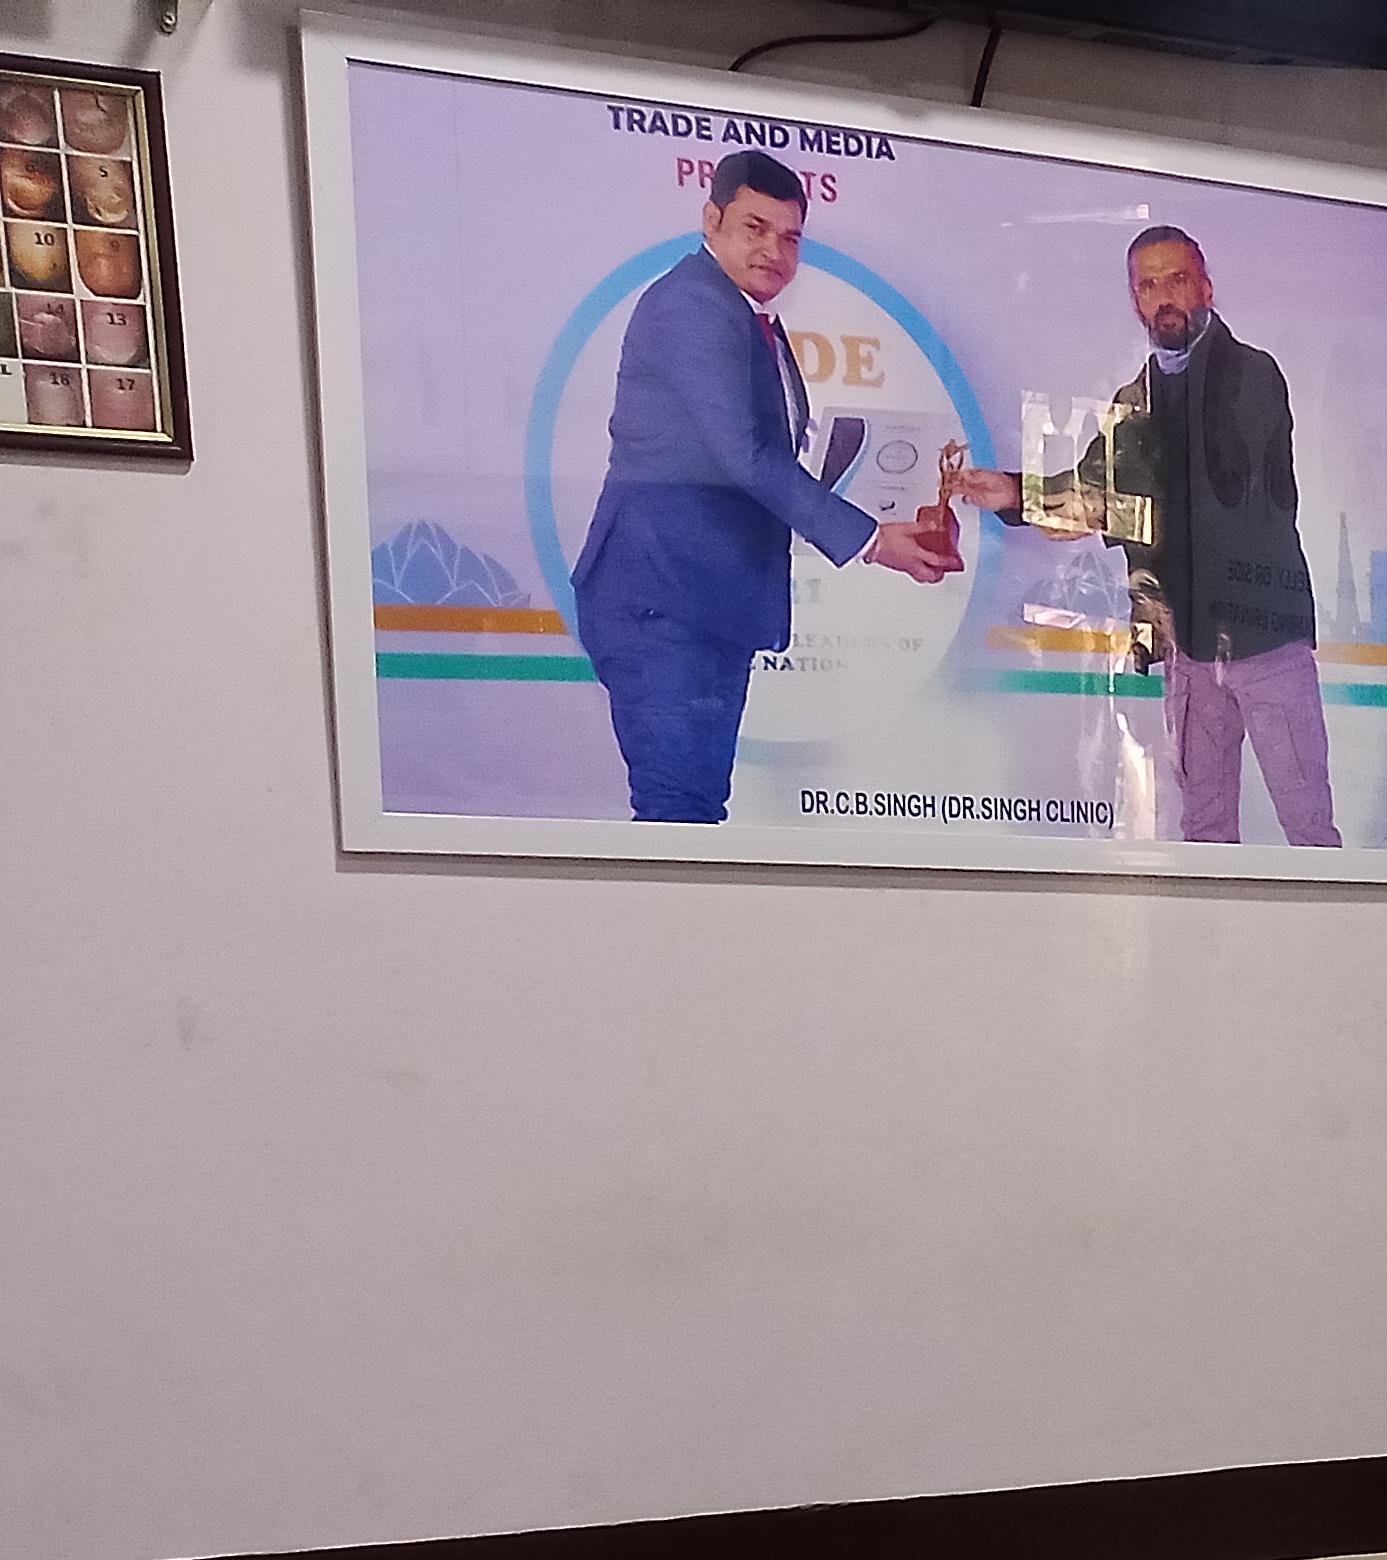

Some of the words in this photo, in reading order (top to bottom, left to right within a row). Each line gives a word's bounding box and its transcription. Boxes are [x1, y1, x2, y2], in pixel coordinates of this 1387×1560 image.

[606, 105, 712, 141] TRADE
[722, 120, 790, 149] AND
[799, 127, 897, 161] MEDIA
[34, 232, 55, 246] 10
[116, 378, 136, 391] 17
[800, 790, 936, 818] DR.C.B.SINGH
[941, 795, 1041, 825] (DR.SINGH
[1046, 799, 1114, 830] CLINIC)
